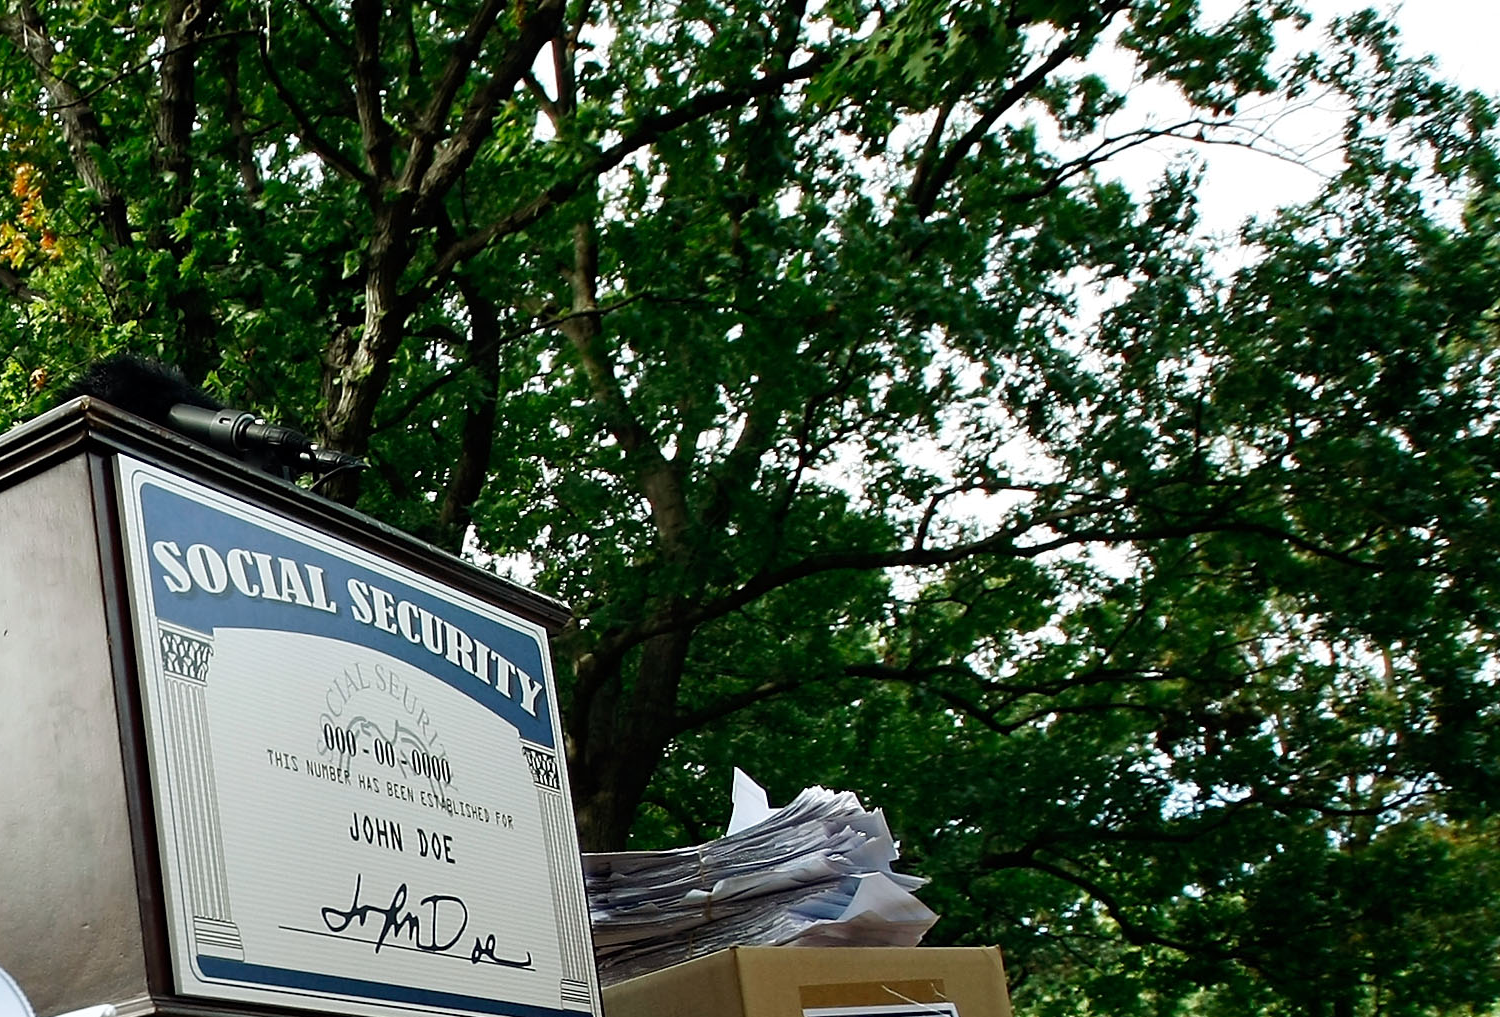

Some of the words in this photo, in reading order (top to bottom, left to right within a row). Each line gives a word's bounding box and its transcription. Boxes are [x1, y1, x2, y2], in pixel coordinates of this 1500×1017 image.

[152, 541, 337, 614] SOCIAL
[347, 578, 543, 718] SECURITY
[266, 749, 299, 773] THIS
[306, 760, 352, 786] NUMBER
[358, 775, 380, 794] HAS
[387, 782, 415, 803] BEEN
[420, 791, 490, 824] ESTABLISHED
[496, 811, 515, 830] FOR
[350, 812, 404, 853] JOHN
[417, 828, 456, 865] DOE
